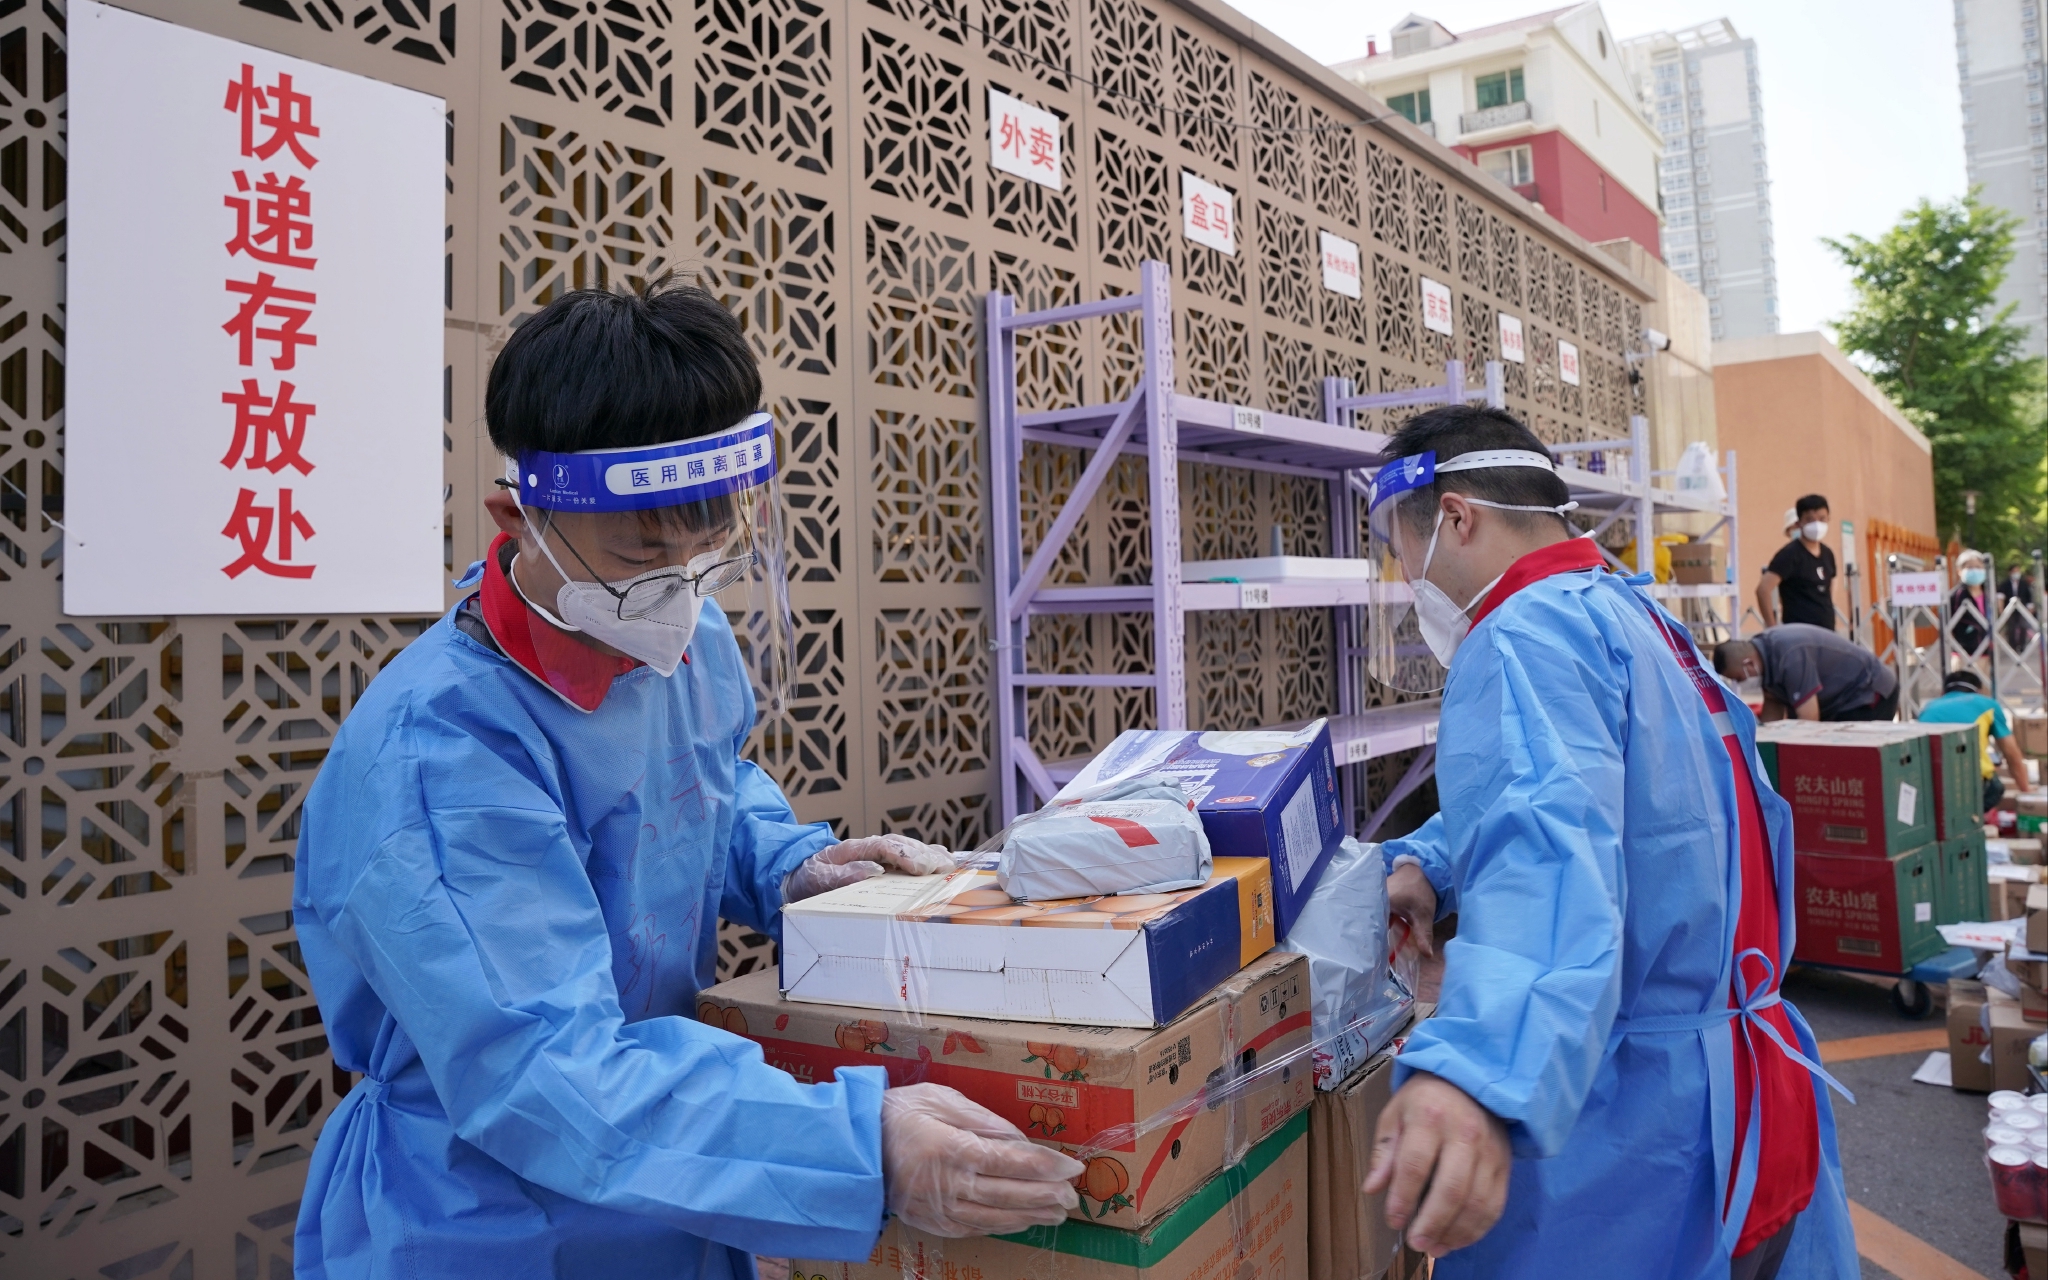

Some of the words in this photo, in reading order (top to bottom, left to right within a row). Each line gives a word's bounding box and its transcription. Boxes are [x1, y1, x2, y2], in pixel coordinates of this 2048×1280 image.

[999, 113, 1055, 171] 外卖
[1190, 193, 1228, 240] 盒马
[221, 63, 320, 580] 快递存放处
[1425, 291, 1450, 324] 京东
[630, 442, 764, 488] 医用隔离面罩
[1794, 774, 1865, 797] 农夫山泉
[1832, 796, 1866, 808] SPRING
[1805, 886, 1878, 911] 农夫山泉
[1844, 909, 1880, 922] SPRING
[1021, 1084, 1074, 1103] 平谷大桃
[1260, 1097, 1292, 1132] 京东快递
